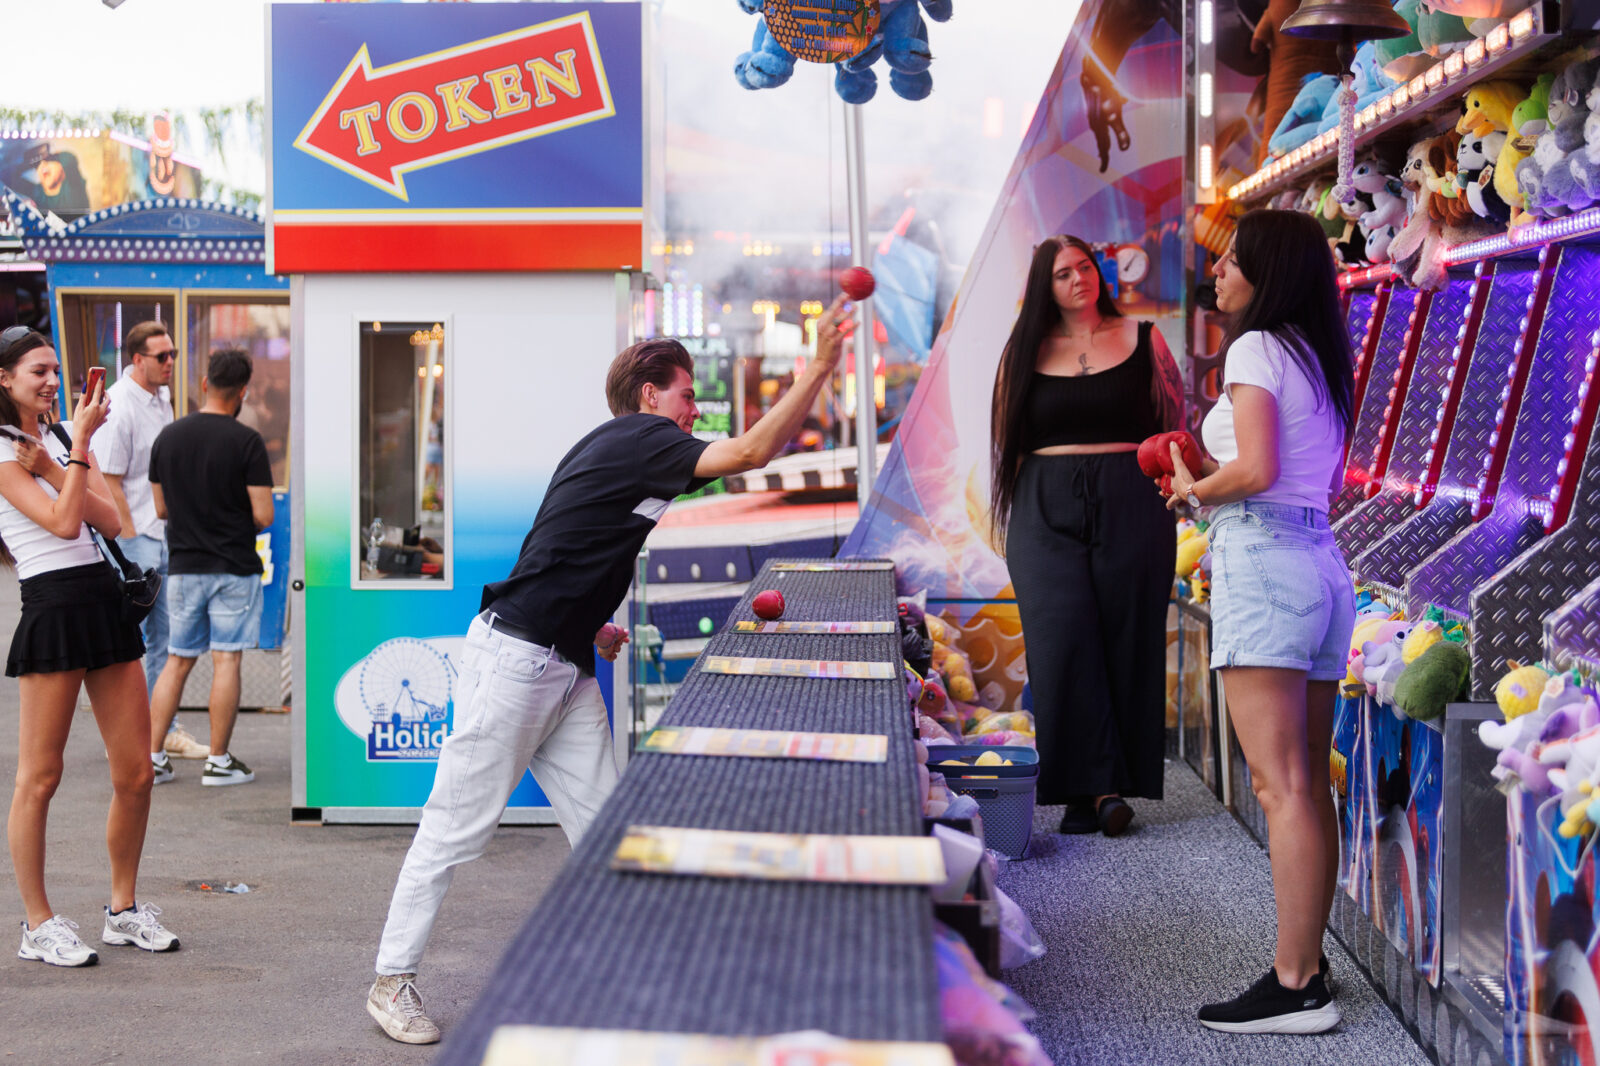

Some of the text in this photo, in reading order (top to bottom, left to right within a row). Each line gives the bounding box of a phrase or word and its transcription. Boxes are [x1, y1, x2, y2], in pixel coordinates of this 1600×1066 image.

[791, 38, 805, 48] LUB
[340, 47, 582, 156] TOKEN
[375, 723, 453, 749] Holid
